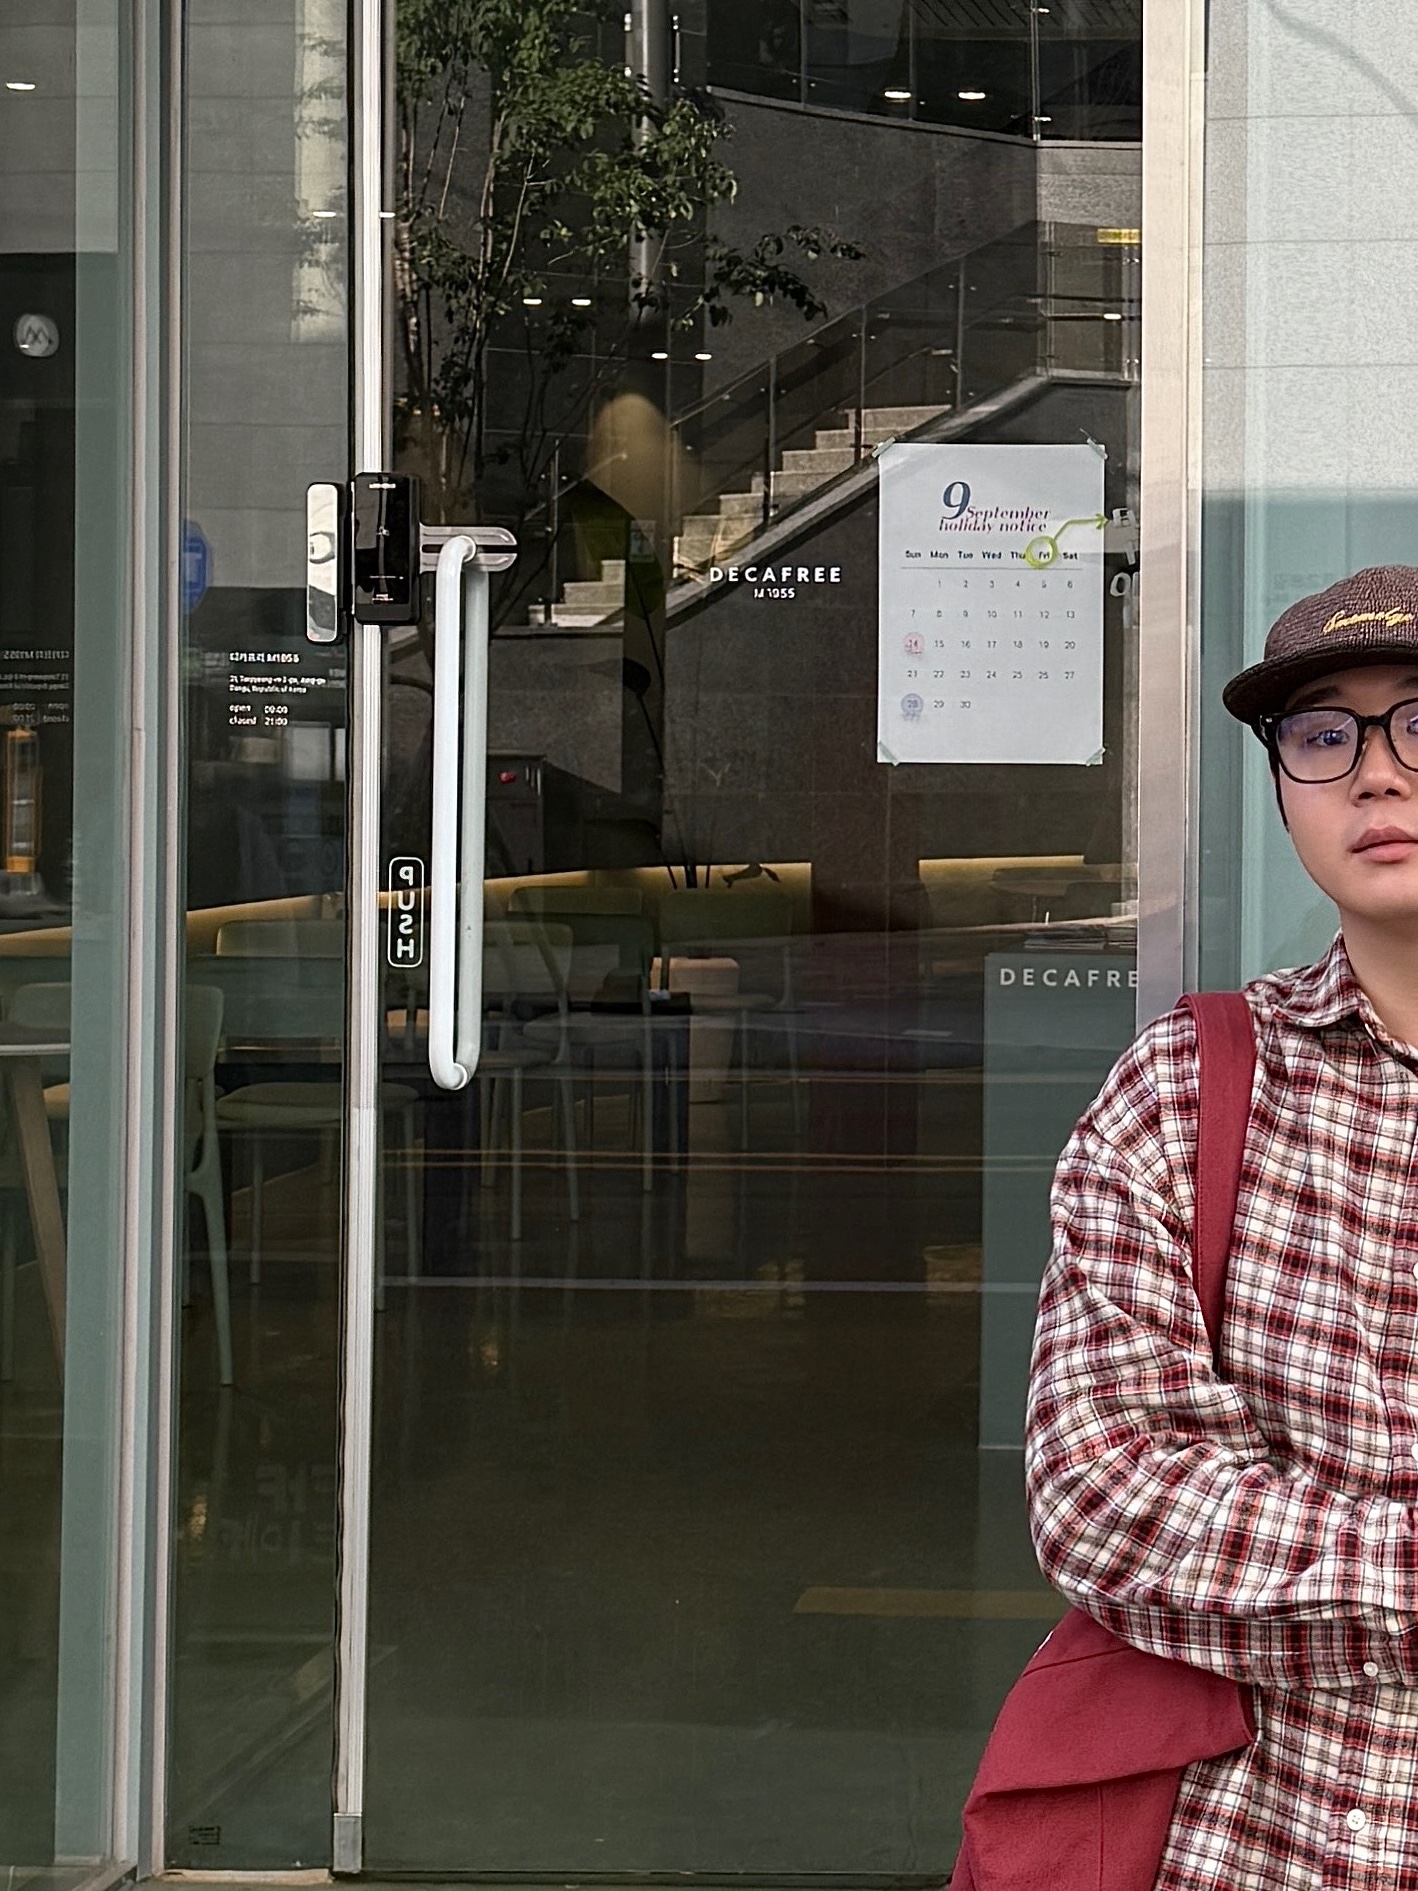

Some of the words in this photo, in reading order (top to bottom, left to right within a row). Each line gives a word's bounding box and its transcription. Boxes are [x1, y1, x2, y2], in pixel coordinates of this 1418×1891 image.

[942, 481, 971, 520] 9
[966, 505, 1051, 522] September
[939, 518, 993, 535] holiday
[999, 519, 1047, 532] notice
[930, 551, 949, 559] Mon
[958, 551, 974, 560] Tue
[981, 551, 1002, 560] Wed
[1062, 551, 1079, 560] Sat
[709, 566, 842, 583] DECAFREE
[963, 580, 969, 588] 2
[989, 580, 995, 588] 3
[1016, 580, 1021, 588] 4
[1064, 641, 1076, 649] 20
